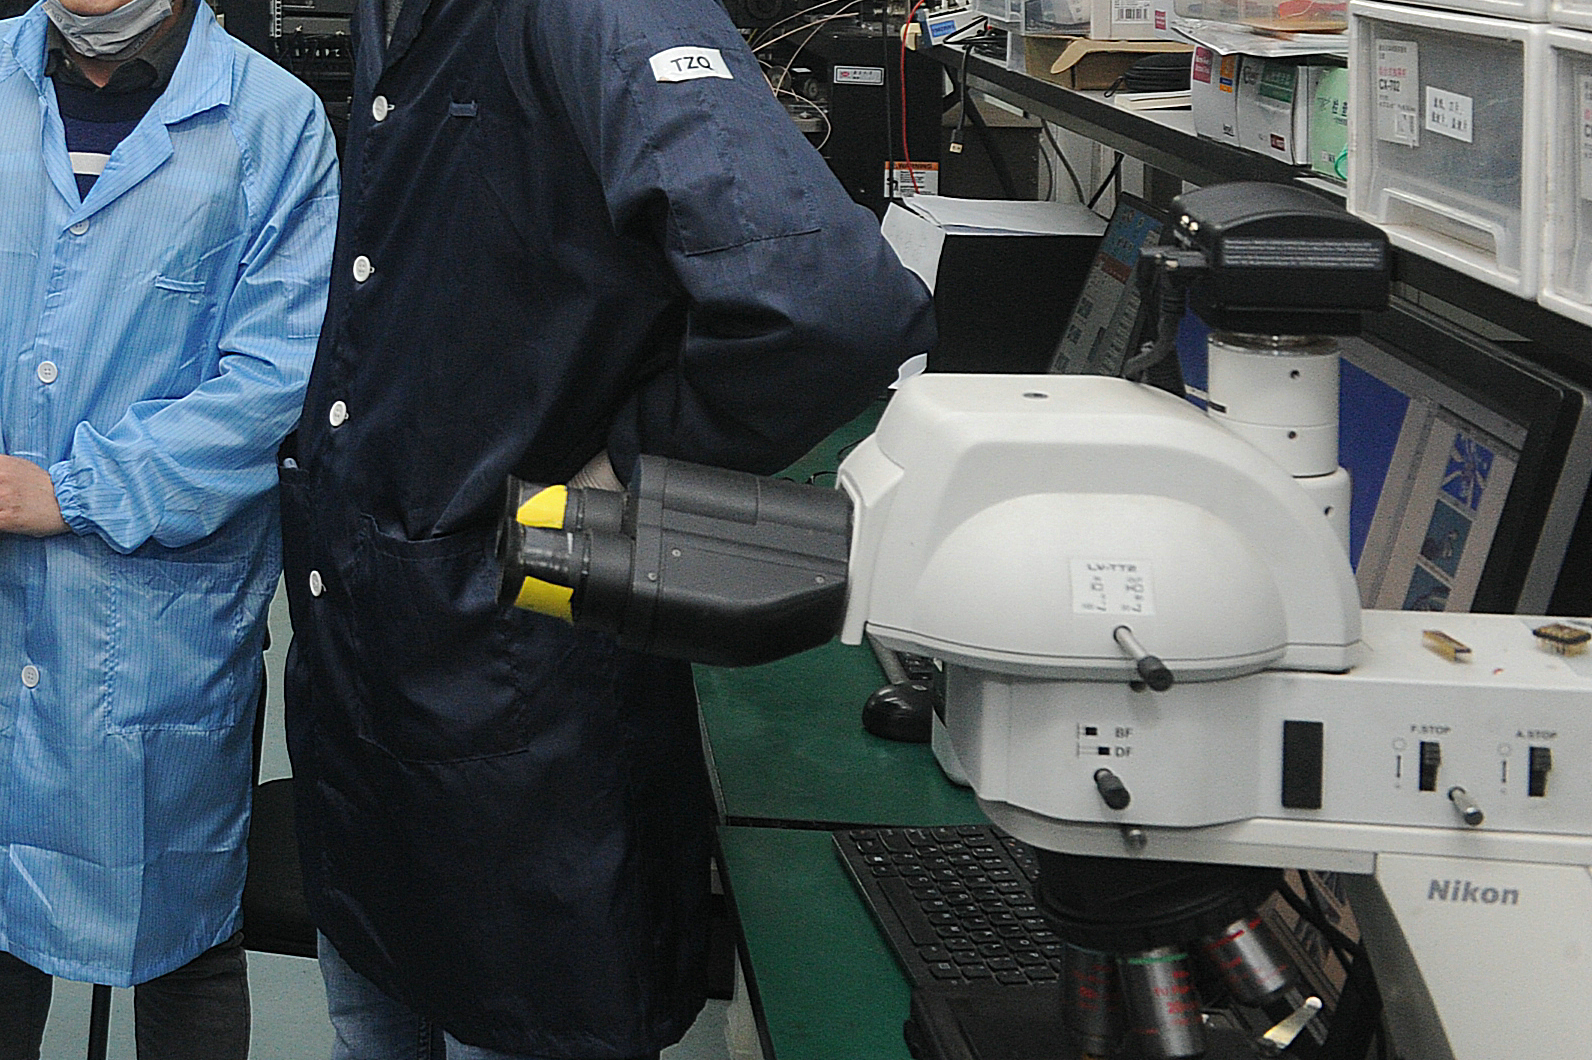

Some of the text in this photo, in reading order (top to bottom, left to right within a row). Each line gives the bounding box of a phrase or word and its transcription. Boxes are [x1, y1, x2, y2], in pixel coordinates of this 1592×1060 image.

[670, 56, 715, 72] TZQ
[1115, 727, 1133, 738] BF
[1115, 746, 1132, 758] DF
[1428, 879, 1519, 905] Nikon
